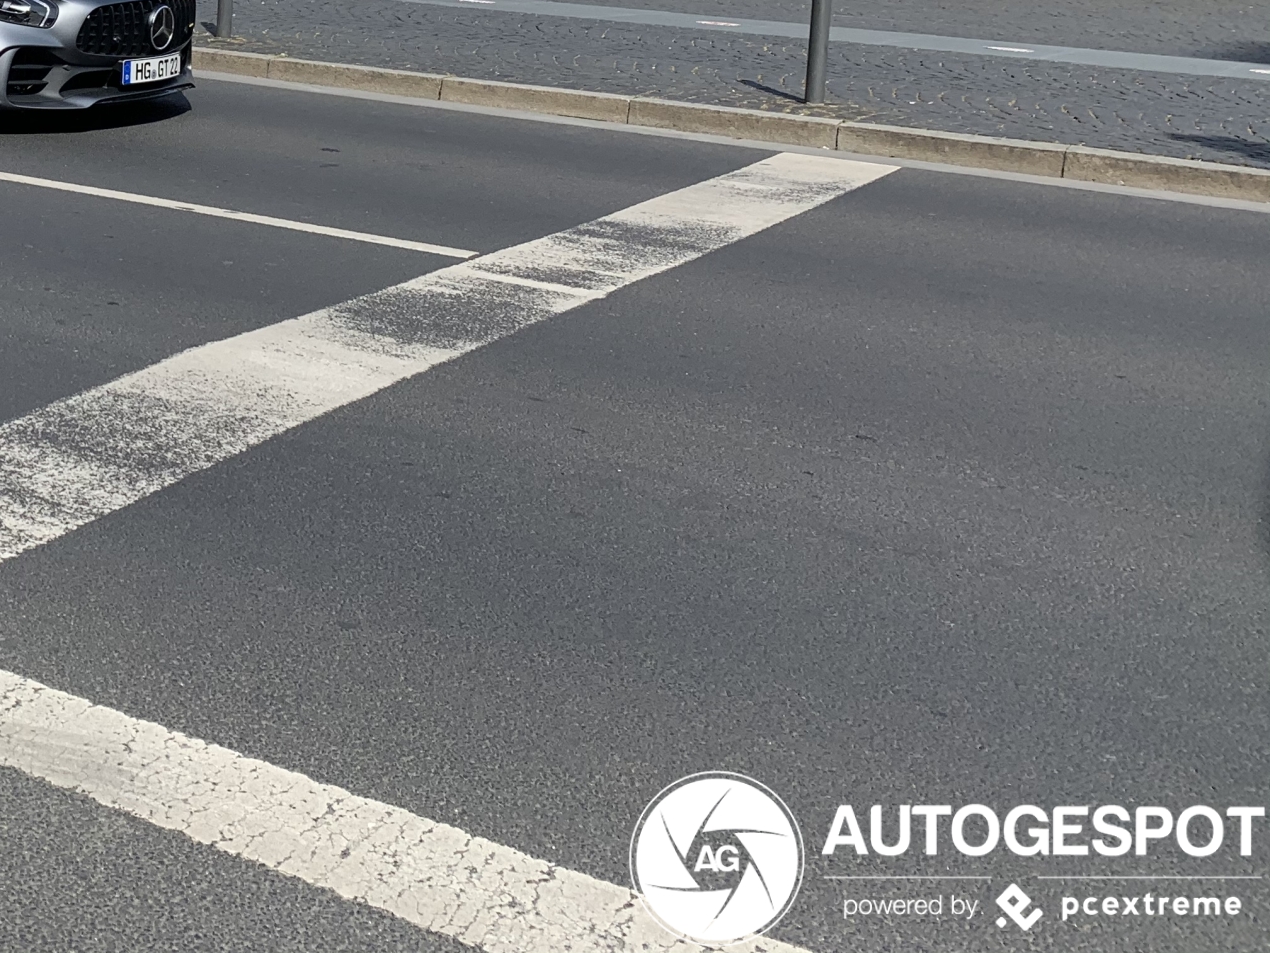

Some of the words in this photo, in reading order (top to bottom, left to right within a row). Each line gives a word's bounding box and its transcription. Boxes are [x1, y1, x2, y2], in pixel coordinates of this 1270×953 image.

[136, 62, 151, 81] HG
[158, 58, 169, 77] GT
[170, 57, 178, 75] 22
